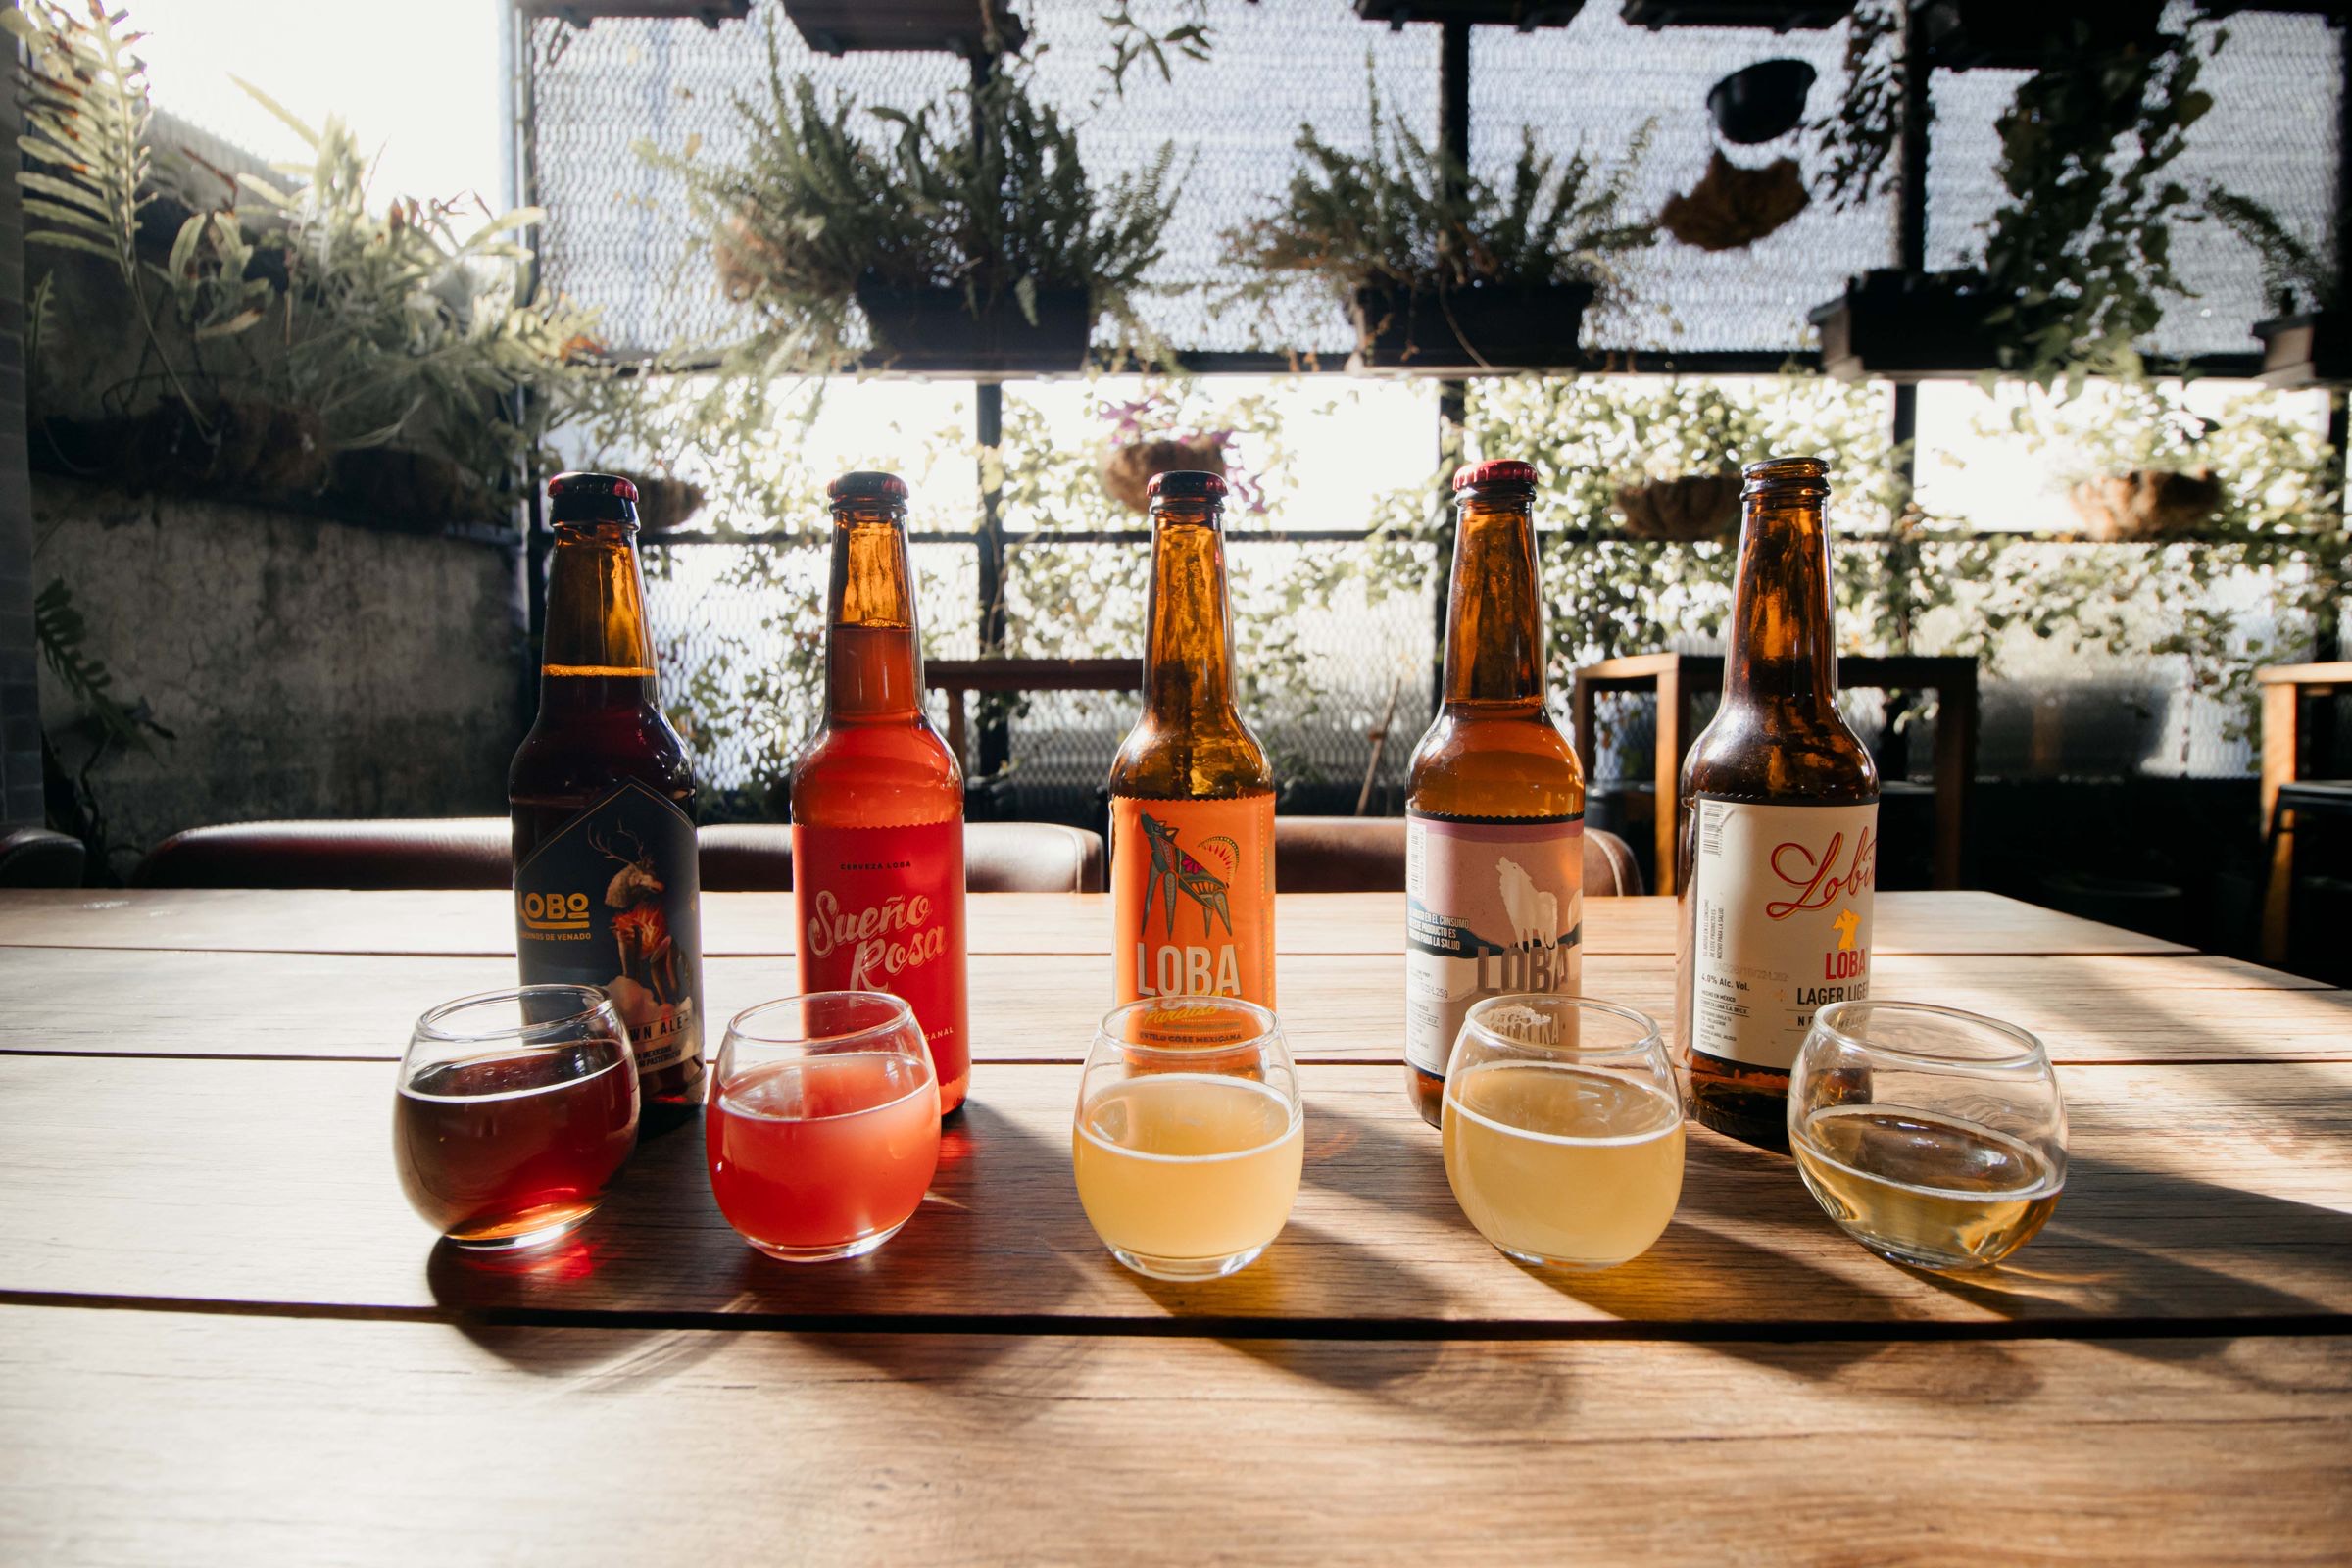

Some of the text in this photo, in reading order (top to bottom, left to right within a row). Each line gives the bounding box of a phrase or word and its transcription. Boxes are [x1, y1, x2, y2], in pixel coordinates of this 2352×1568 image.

[886, 860, 911, 869] LOBA
[517, 891, 590, 930] LOBO
[1432, 913, 1440, 925] EL
[1439, 916, 1470, 929] CONSUMO
[808, 890, 932, 957] Sueño
[1448, 928, 1457, 939] ES
[545, 932, 556, 941] DE
[557, 931, 592, 941] VENADO
[1433, 936, 1441, 947] LA
[1440, 938, 1460, 951] SALUD
[850, 926, 947, 996] Rosa
[1137, 941, 1242, 998] LOBA
[1477, 944, 1569, 995] LOBA
[1825, 948, 1866, 980] LOBA
[1701, 973, 1750, 992] 4.0% Alc. Vol.
[1796, 982, 1867, 1005] LAGER LIGE
[661, 1016, 684, 1036] ALE
